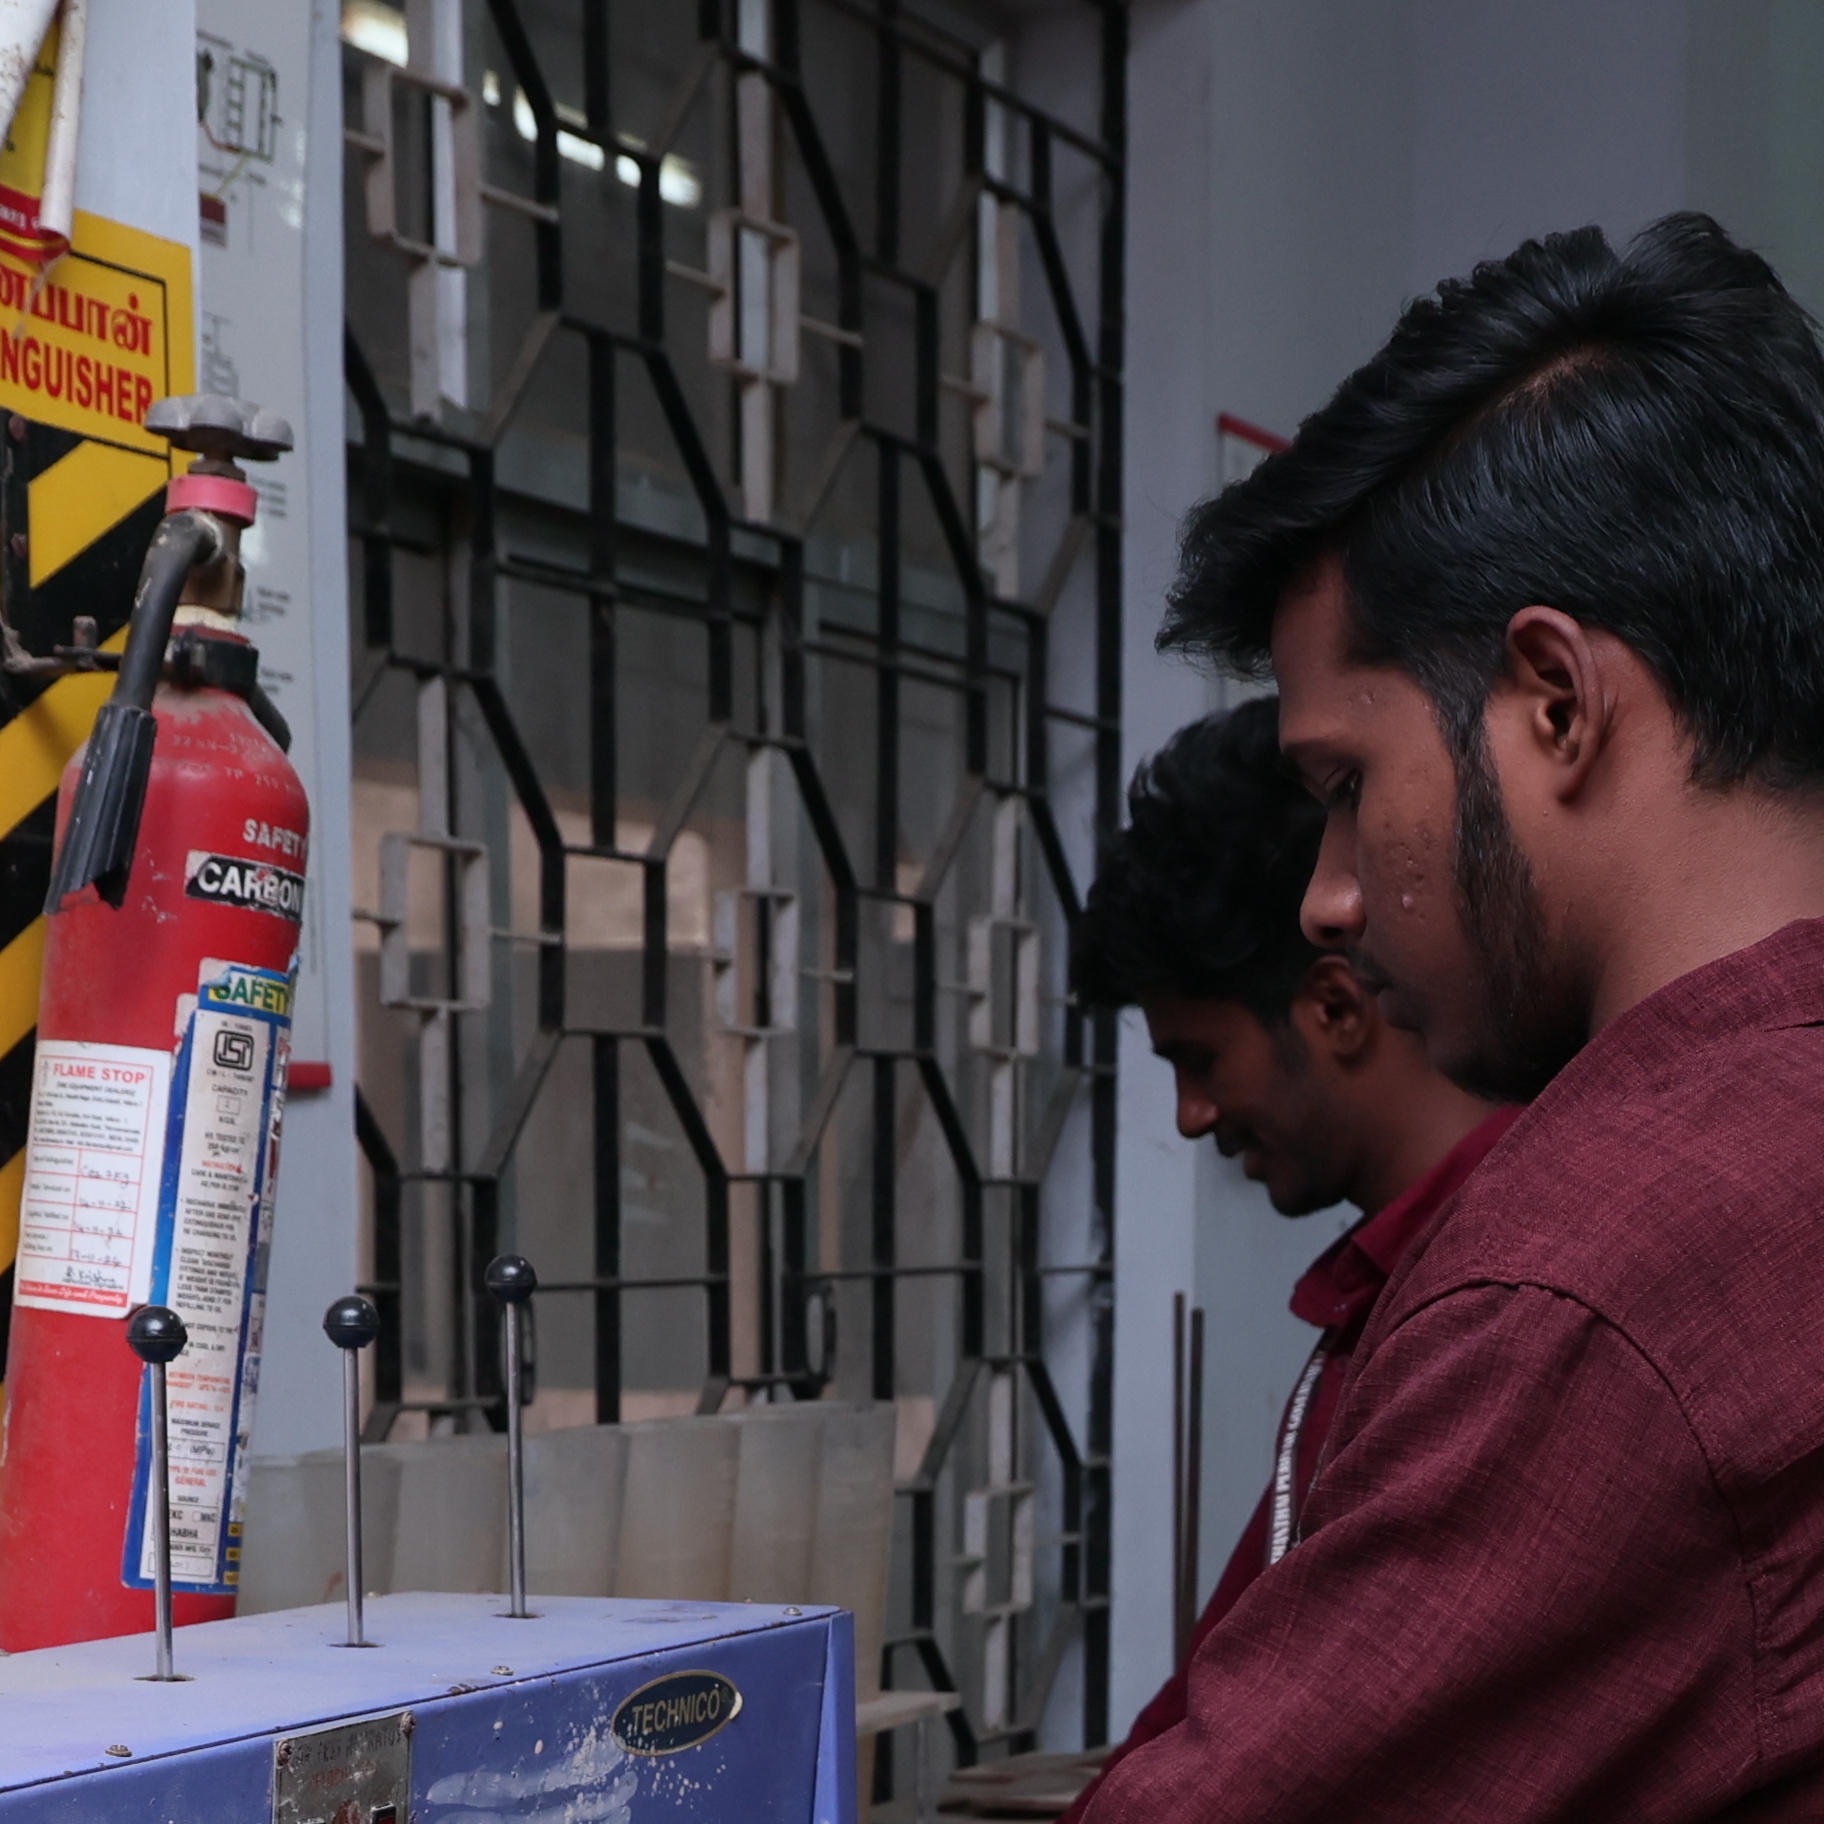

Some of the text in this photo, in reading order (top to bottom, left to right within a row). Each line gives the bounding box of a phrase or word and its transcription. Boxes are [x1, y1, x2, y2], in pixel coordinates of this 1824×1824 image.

[54, 1063, 146, 1084] FLAME STOP
[632, 1689, 720, 1737] TECHNICO
